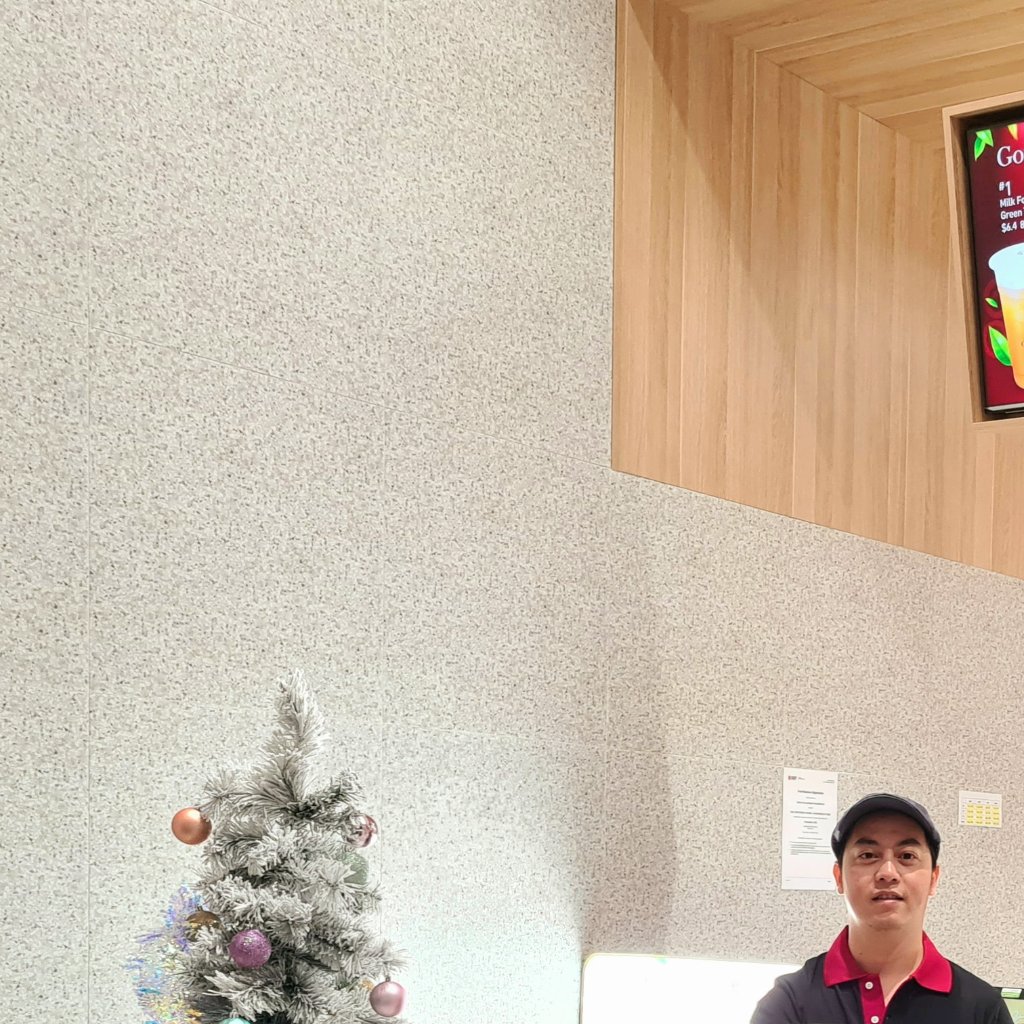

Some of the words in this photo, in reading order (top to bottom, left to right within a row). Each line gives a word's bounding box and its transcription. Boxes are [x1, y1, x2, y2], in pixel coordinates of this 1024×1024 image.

[999, 181, 1011, 196] #1
[1000, 198, 1015, 208] Milk
[1000, 209, 1022, 220] Green
[1001, 221, 1017, 233] $6.4
